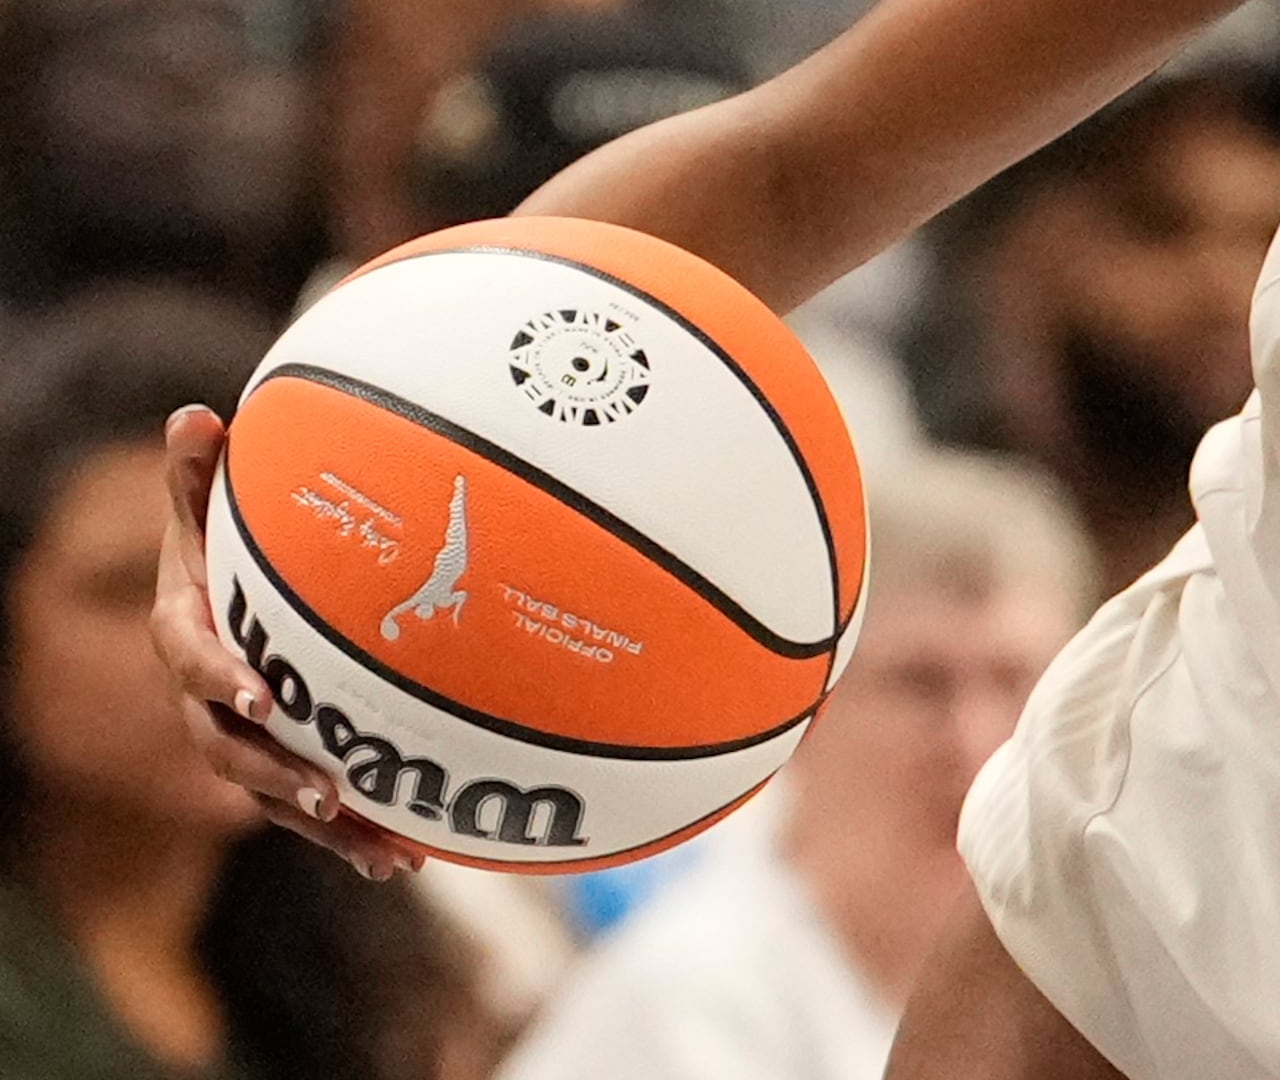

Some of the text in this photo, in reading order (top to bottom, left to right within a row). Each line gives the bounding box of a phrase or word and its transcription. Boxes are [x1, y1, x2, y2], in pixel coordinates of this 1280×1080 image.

[497, 582, 644, 655] FINALS BALL
[511, 609, 614, 663] OFFICIAL
[227, 571, 590, 848] Wilson
